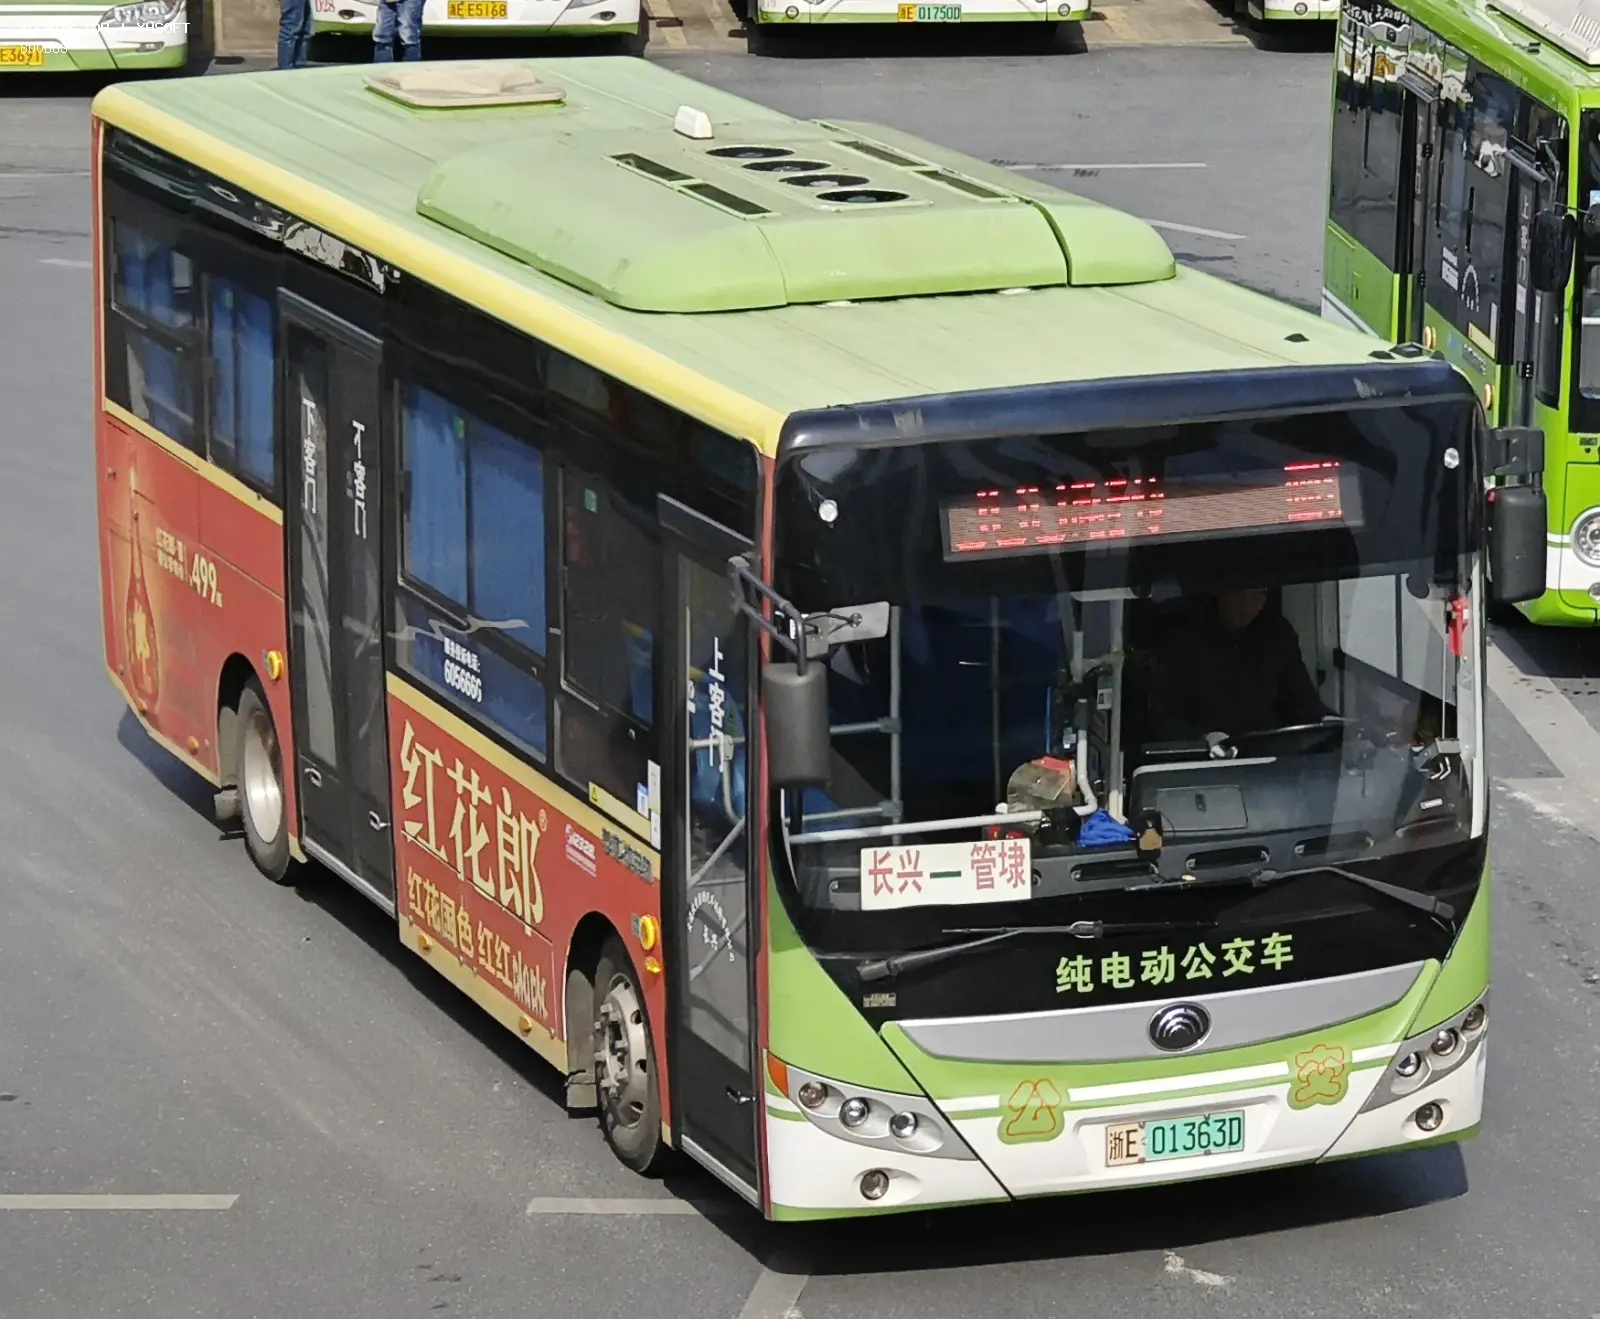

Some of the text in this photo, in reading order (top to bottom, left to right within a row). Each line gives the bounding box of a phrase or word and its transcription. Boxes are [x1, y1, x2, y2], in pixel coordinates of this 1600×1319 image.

[1055, 931, 1295, 994] 纯电动公交车
